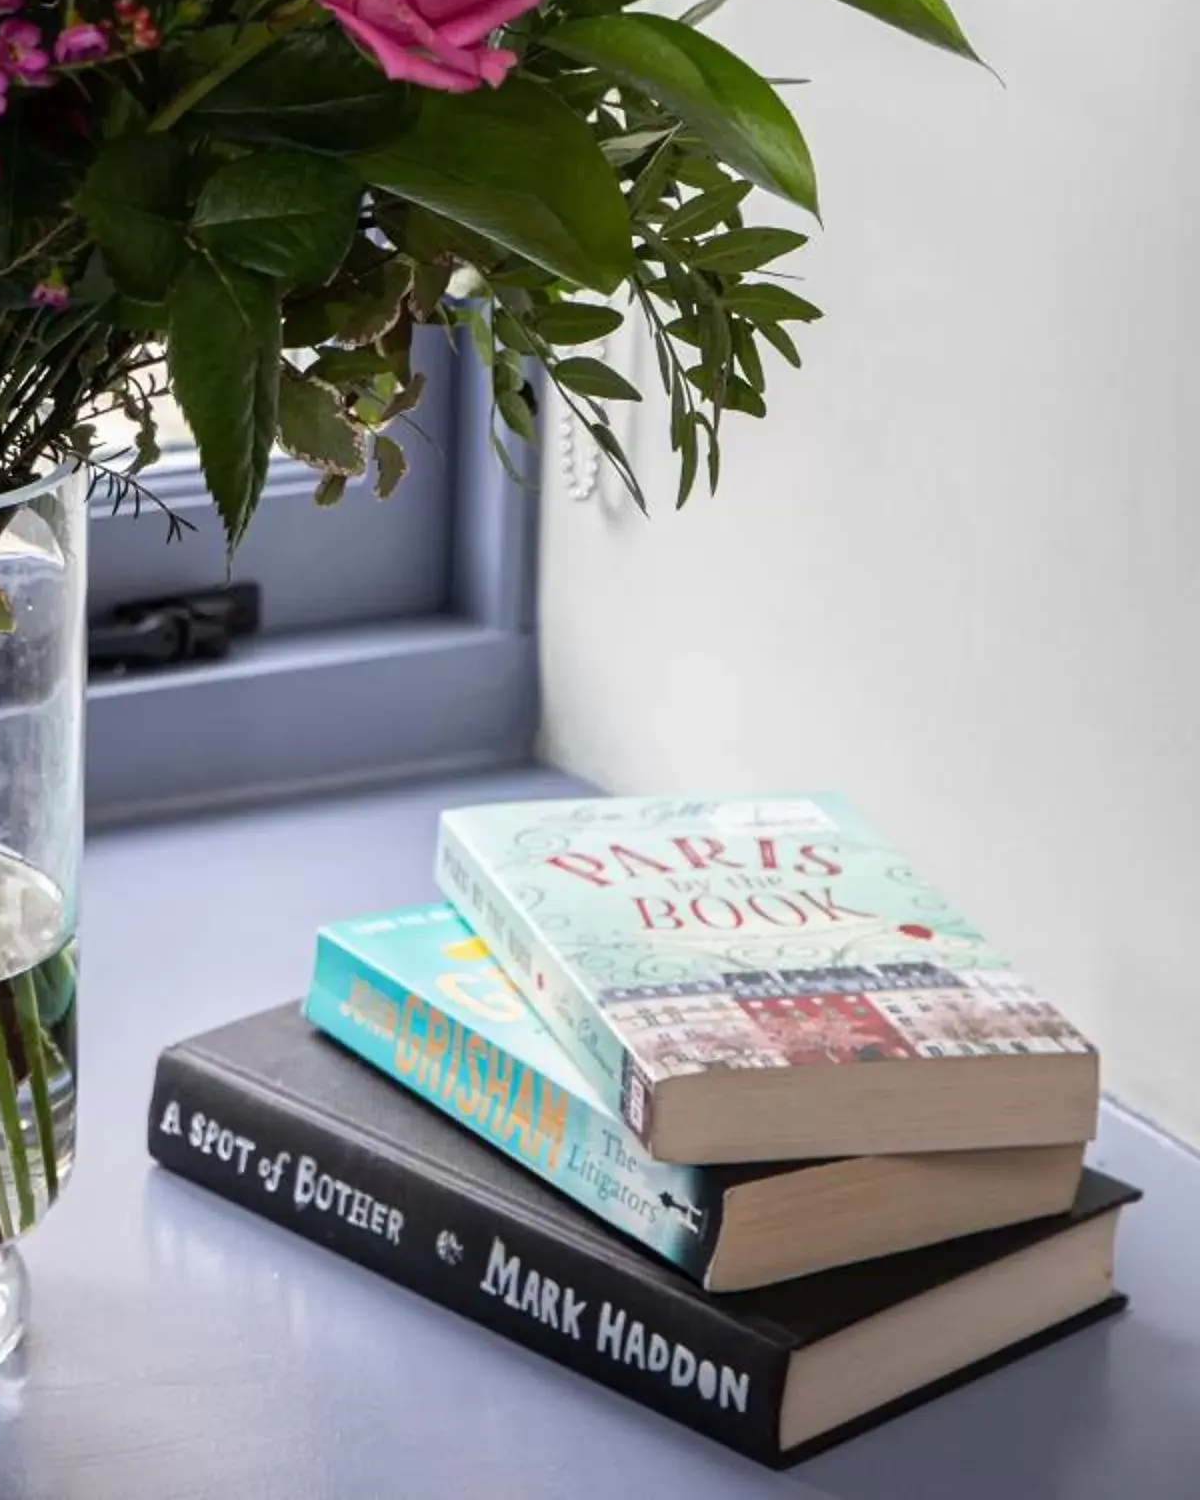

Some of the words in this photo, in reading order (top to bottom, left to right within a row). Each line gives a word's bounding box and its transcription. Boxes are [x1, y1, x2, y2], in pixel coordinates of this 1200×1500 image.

[543, 836, 843, 888] PARIS
[667, 875, 711, 897] by
[724, 871, 784, 891] the
[631, 887, 879, 930] BOOK
[394, 994, 569, 1172] GRISHAM
[159, 1100, 183, 1137] A
[188, 1111, 256, 1175] SPOT
[258, 1150, 291, 1193] of
[294, 1155, 405, 1246] BOTHER
[567, 1143, 659, 1224] Litigators
[601, 1128, 638, 1173] The
[479, 1235, 588, 1341] MARK
[596, 1301, 751, 1413] HADDON
